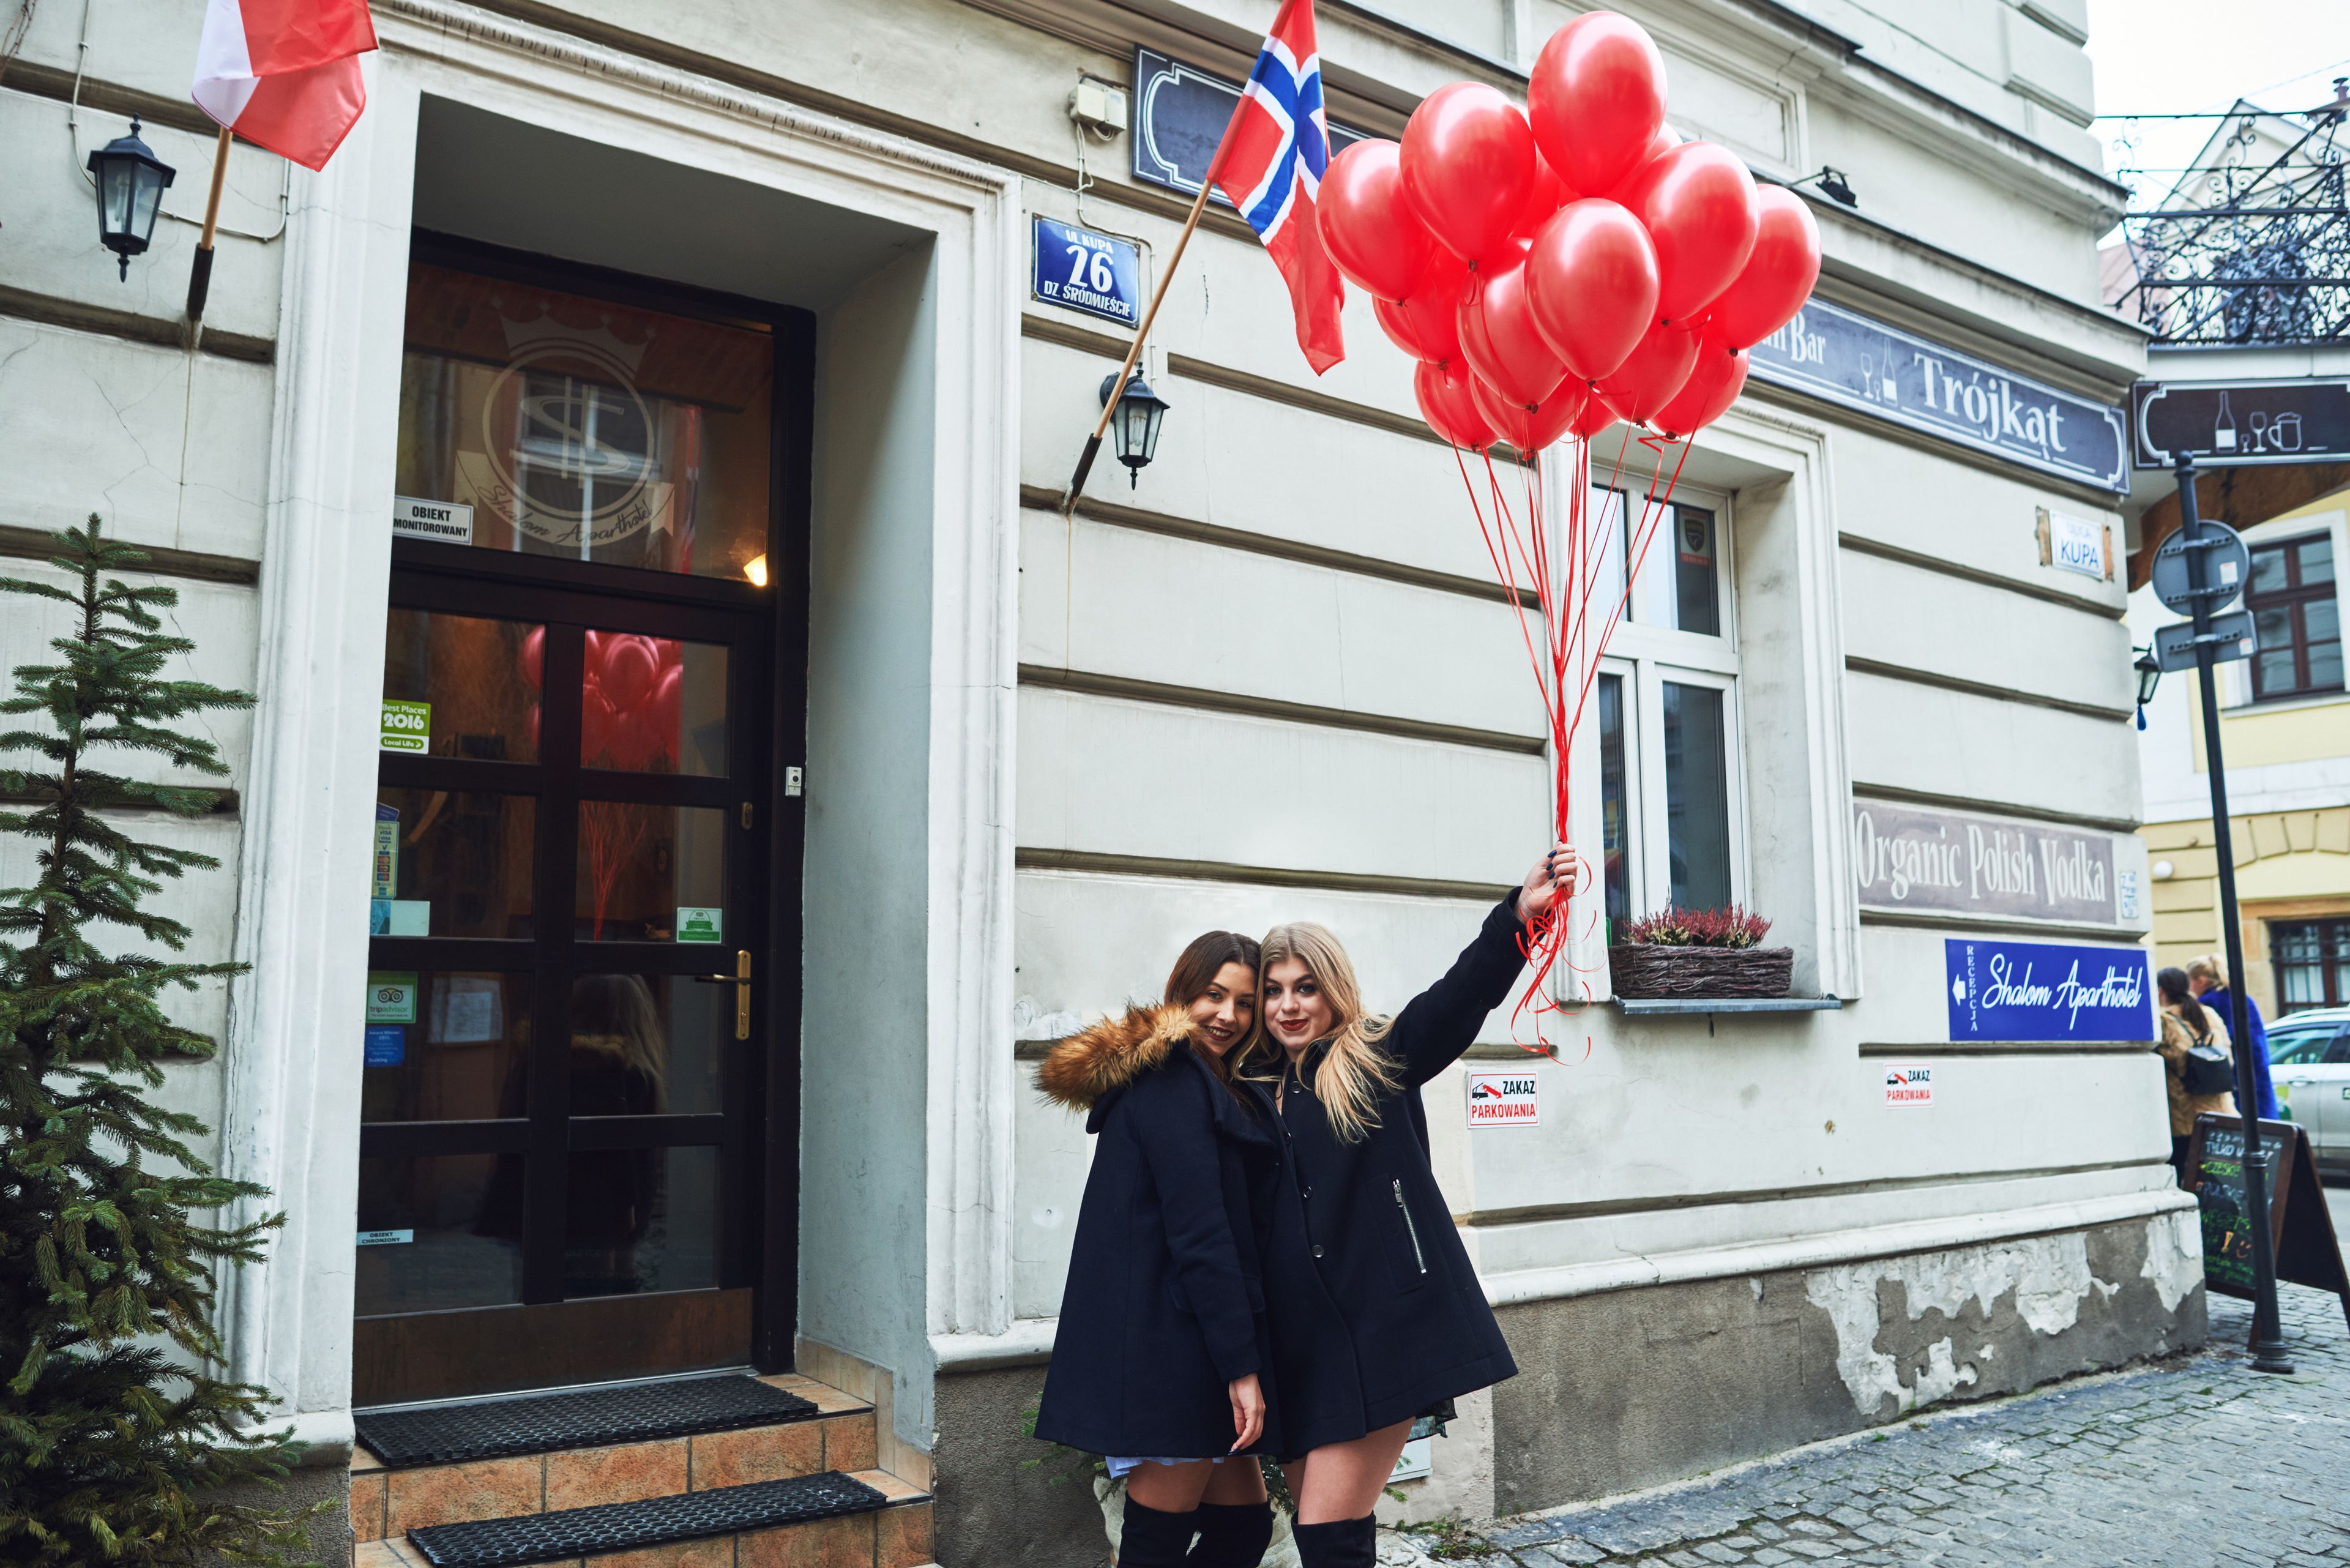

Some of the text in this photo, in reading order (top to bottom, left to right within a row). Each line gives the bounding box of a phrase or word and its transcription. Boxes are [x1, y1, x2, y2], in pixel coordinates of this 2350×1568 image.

[1082, 234, 1113, 254] KUPA
[1066, 245, 1114, 292] 26
[1044, 280, 1130, 316] DZ. ŚRÓDMIEŚCIE
[1791, 311, 1826, 364] Bar
[1914, 353, 2067, 460] Trójkąt
[412, 506, 451, 521] OBIEKT
[477, 485, 652, 543] Shalom Aparthotel
[394, 518, 467, 537] MONITOROWANY
[2061, 539, 2099, 568] KUPA
[382, 703, 427, 715] Best Places
[383, 712, 425, 730] 2016
[1856, 811, 1963, 900] Organic
[1967, 824, 2036, 899] Polish
[2039, 838, 2106, 906] Vodka
[1966, 945, 1978, 1031] RECEPCJA
[1982, 953, 2143, 1030] Shalom Aparthotel
[1503, 1081, 1535, 1094] ZAKAZ
[1908, 1070, 1930, 1081] ZAKAZ
[1887, 1089, 1930, 1100] PARKOWANIA
[1472, 1103, 1536, 1118] PARKOWANIA
